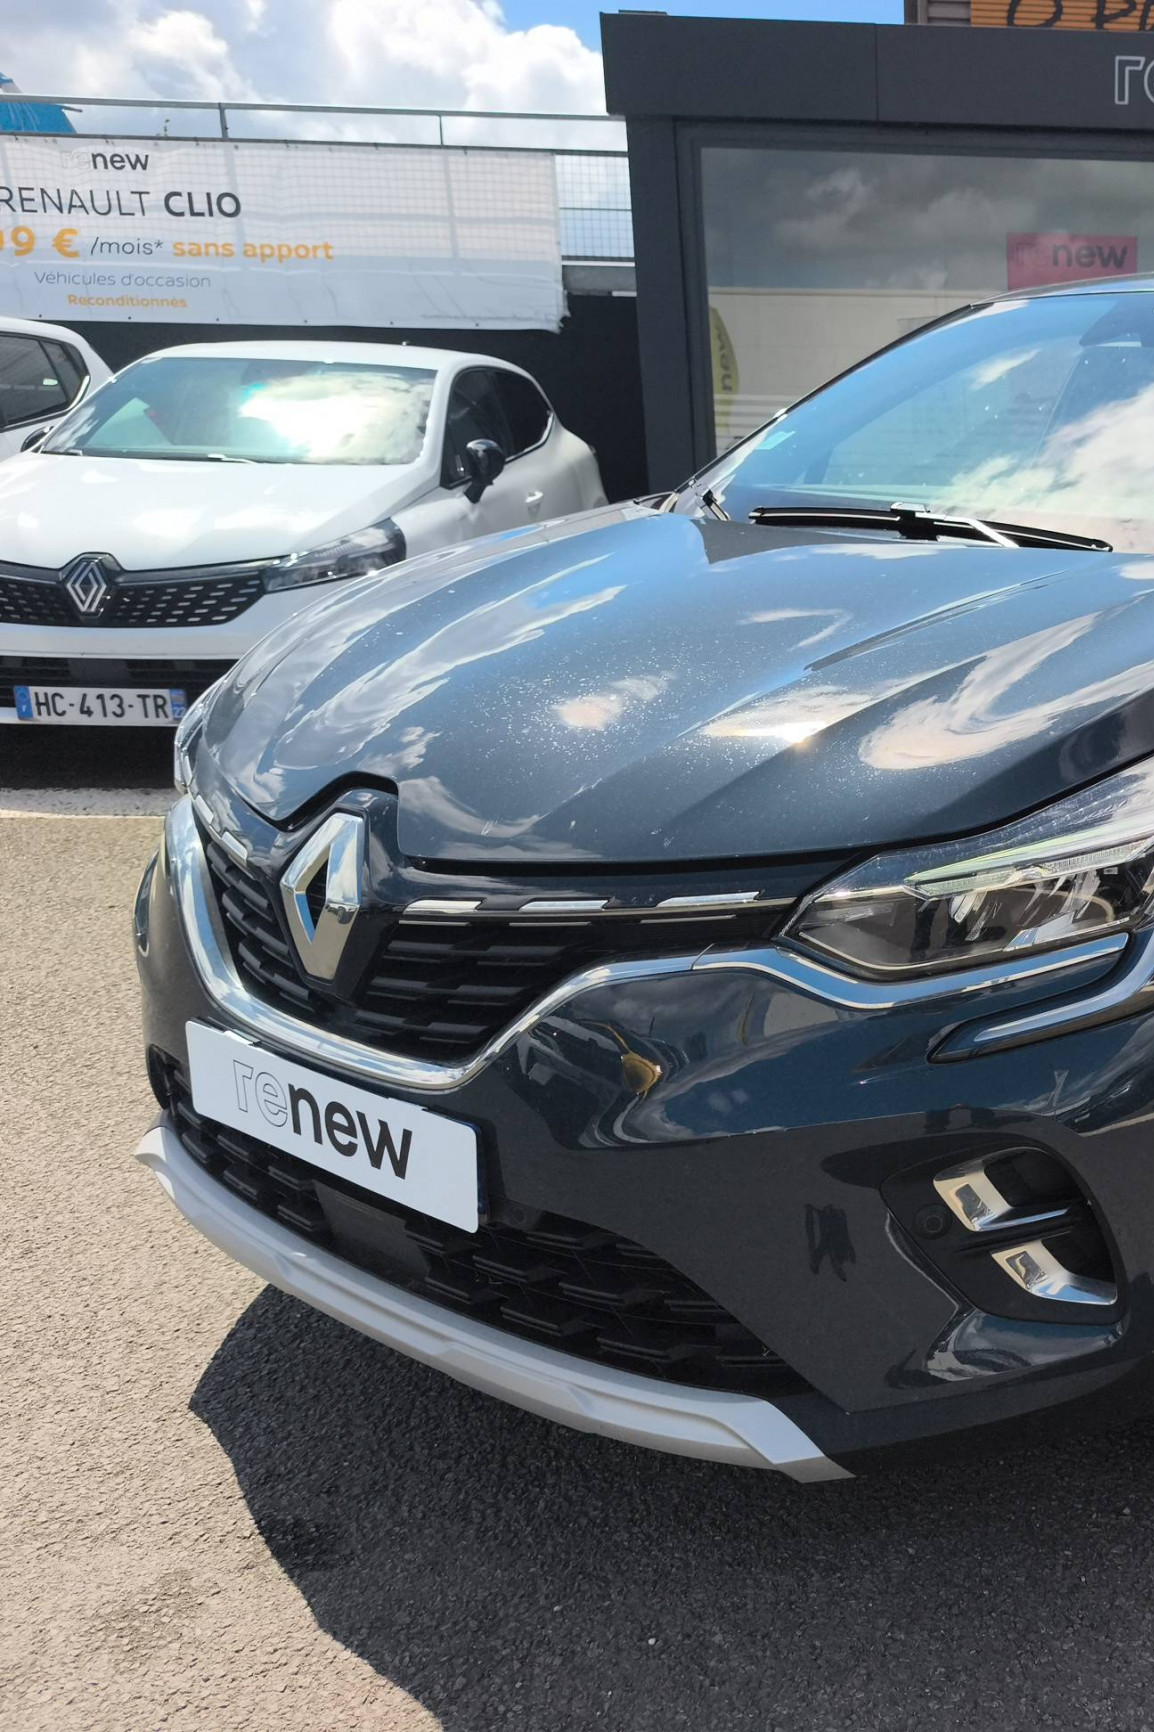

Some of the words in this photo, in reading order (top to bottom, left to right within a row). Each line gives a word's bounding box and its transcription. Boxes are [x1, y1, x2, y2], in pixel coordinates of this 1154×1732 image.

[0, 186, 150, 216] RENAULT
[164, 191, 242, 218] CLIO
[0, 225, 36, 257] 9
[52, 228, 80, 258] €
[172, 241, 235, 258] sans
[242, 241, 334, 264] apport
[34, 270, 116, 287] Véhicules
[66, 294, 188, 308] Reconditionnés
[34, 691, 170, 719] HC-413-TR
[232, 1059, 413, 1180] renew
